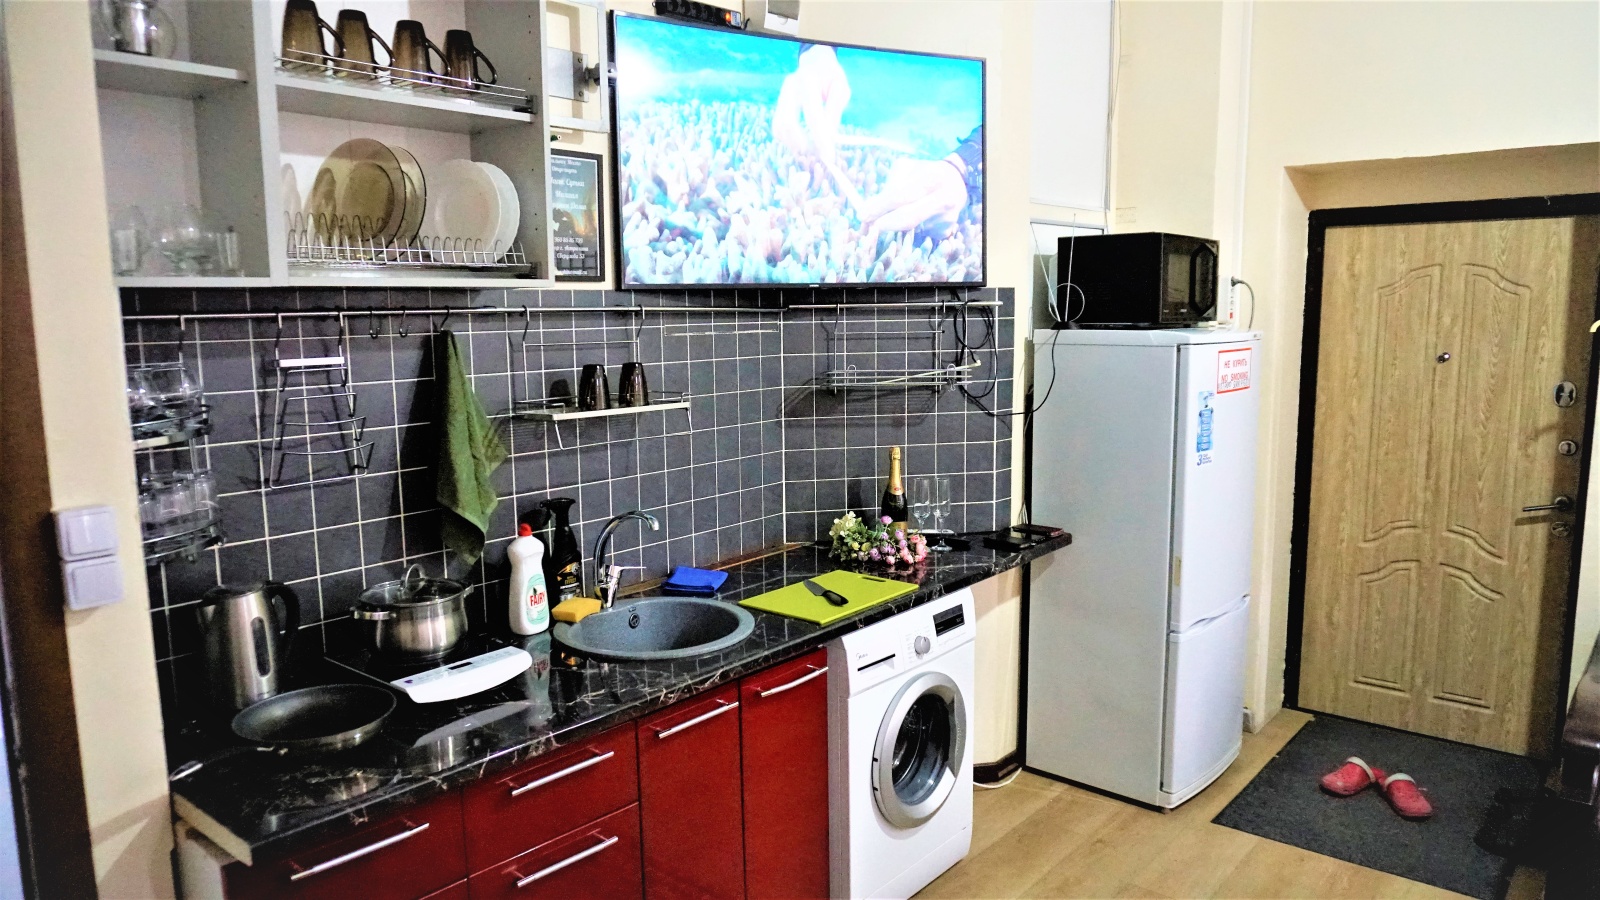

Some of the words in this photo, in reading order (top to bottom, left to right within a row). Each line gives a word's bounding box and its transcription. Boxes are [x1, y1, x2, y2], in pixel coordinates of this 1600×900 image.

[1224, 360, 1231, 369] НЕ
[1233, 358, 1248, 368] КУРИТЬ
[1221, 374, 1228, 383] NO
[1230, 371, 1249, 382] SMOKING
[529, 591, 546, 607] FAIRY
